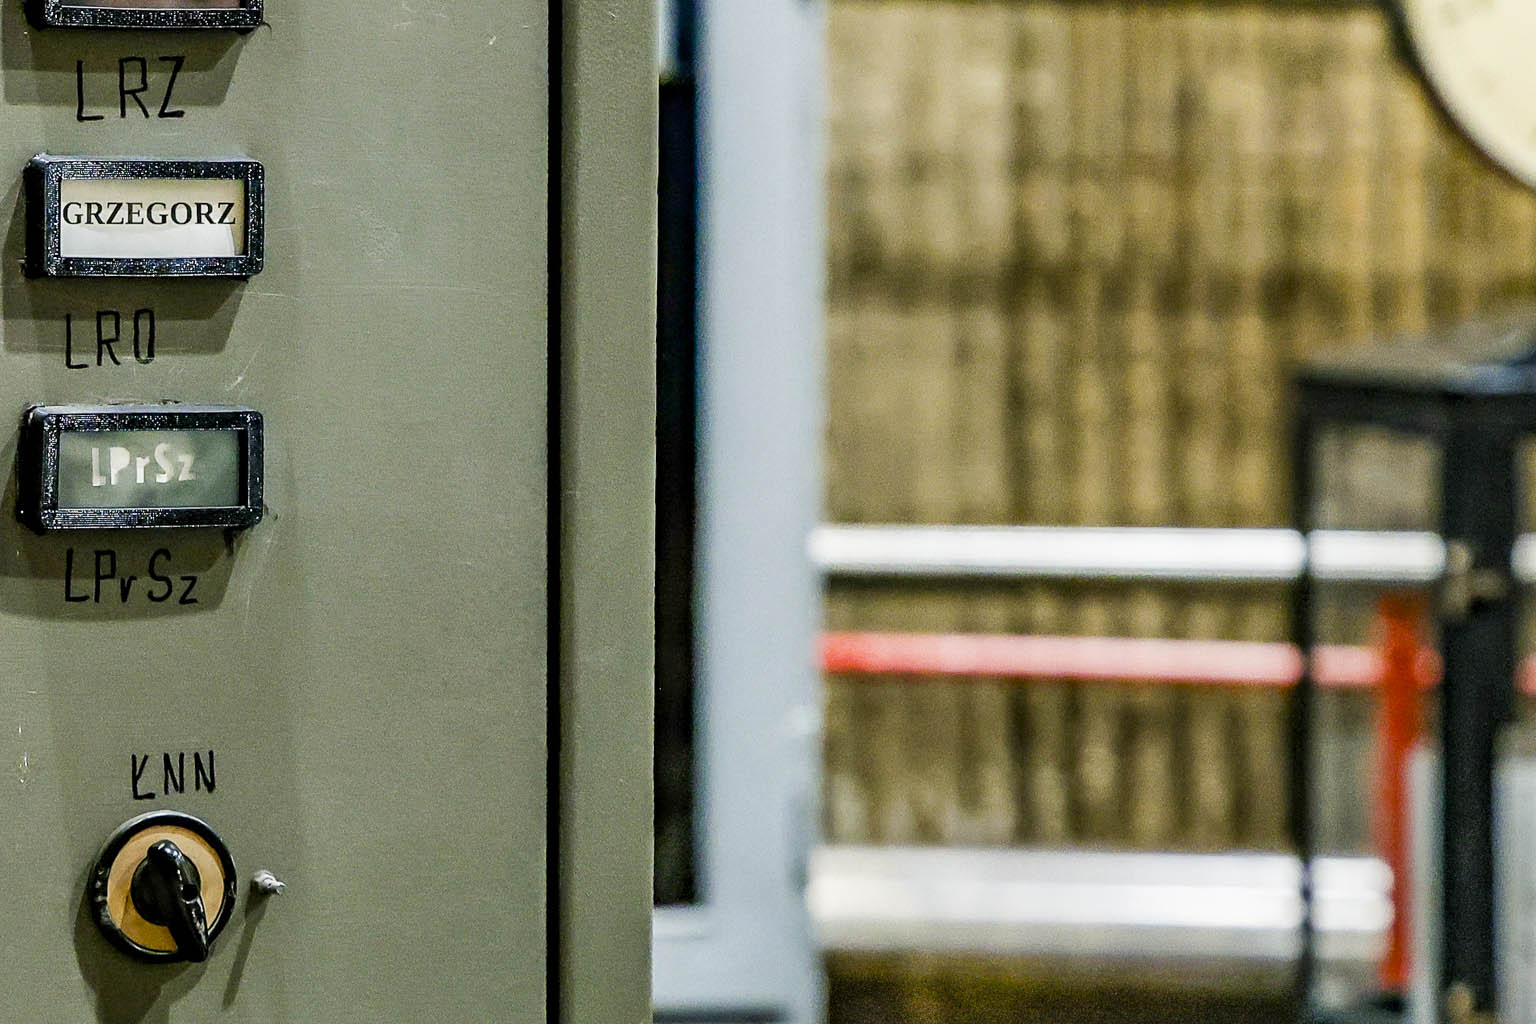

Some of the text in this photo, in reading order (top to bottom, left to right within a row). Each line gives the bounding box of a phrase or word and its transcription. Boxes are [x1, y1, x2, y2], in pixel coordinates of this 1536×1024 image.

[76, 56, 185, 121] LRZ
[63, 200, 236, 226] GRZEGORZ
[91, 444, 195, 486] LPrSz
[65, 548, 198, 604] LPrSz
